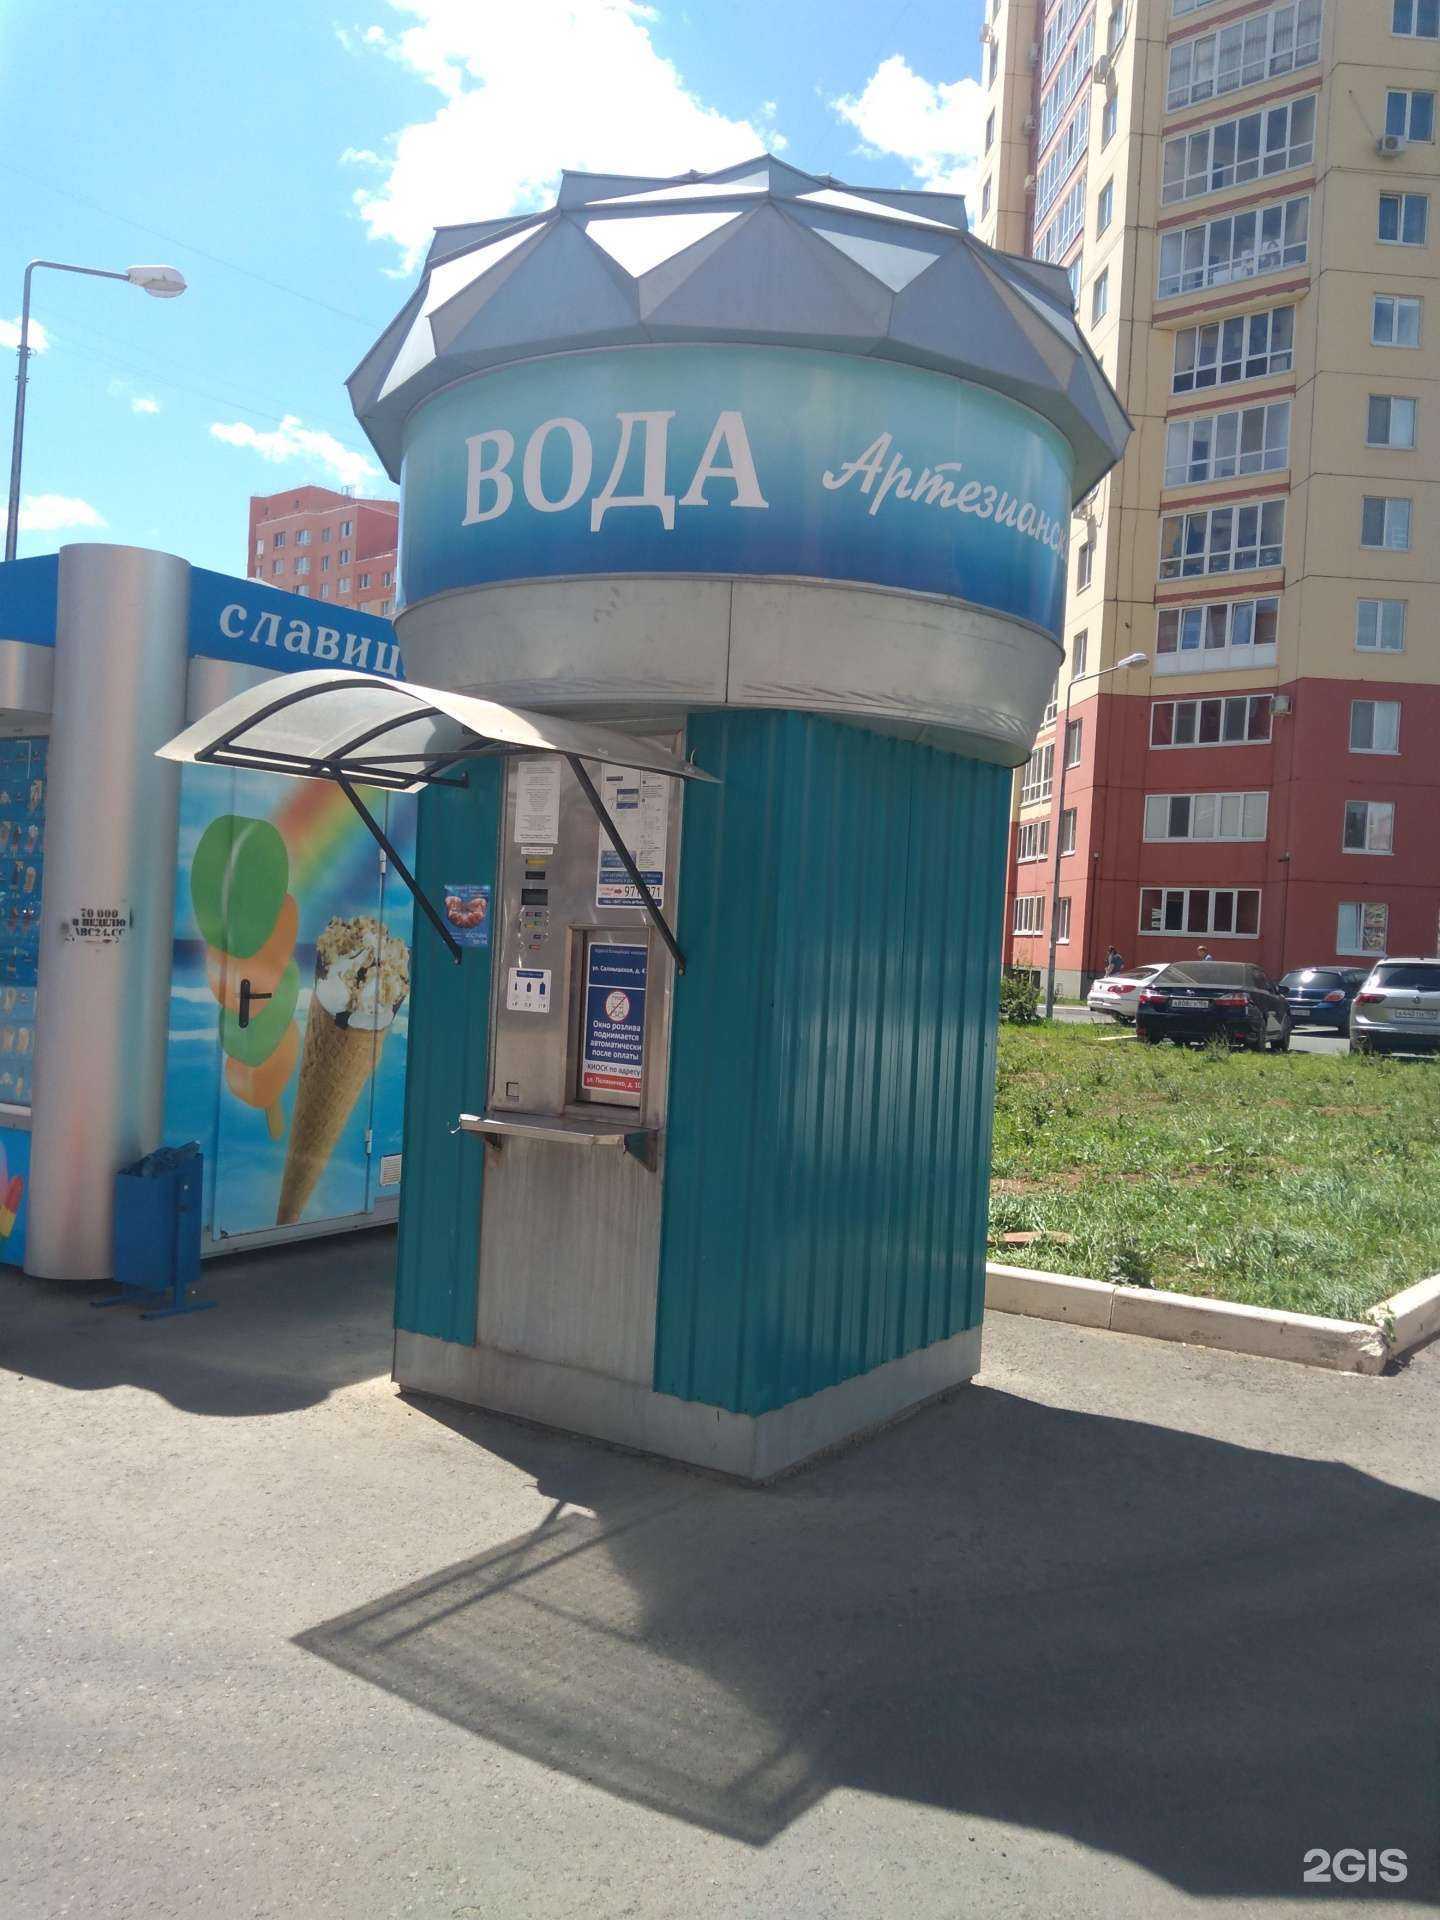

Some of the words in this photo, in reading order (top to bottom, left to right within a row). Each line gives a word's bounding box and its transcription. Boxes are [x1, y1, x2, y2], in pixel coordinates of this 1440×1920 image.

[461, 411, 769, 532] ВОДА
[97, 909, 119, 918] 000
[593, 1020, 611, 1029] Окно
[612, 1023, 641, 1032] розлива
[593, 1031, 640, 1041] поднимается
[590, 1040, 641, 1051] автоматически
[592, 1050, 612, 1058] после
[613, 1052, 639, 1060] оплаты
